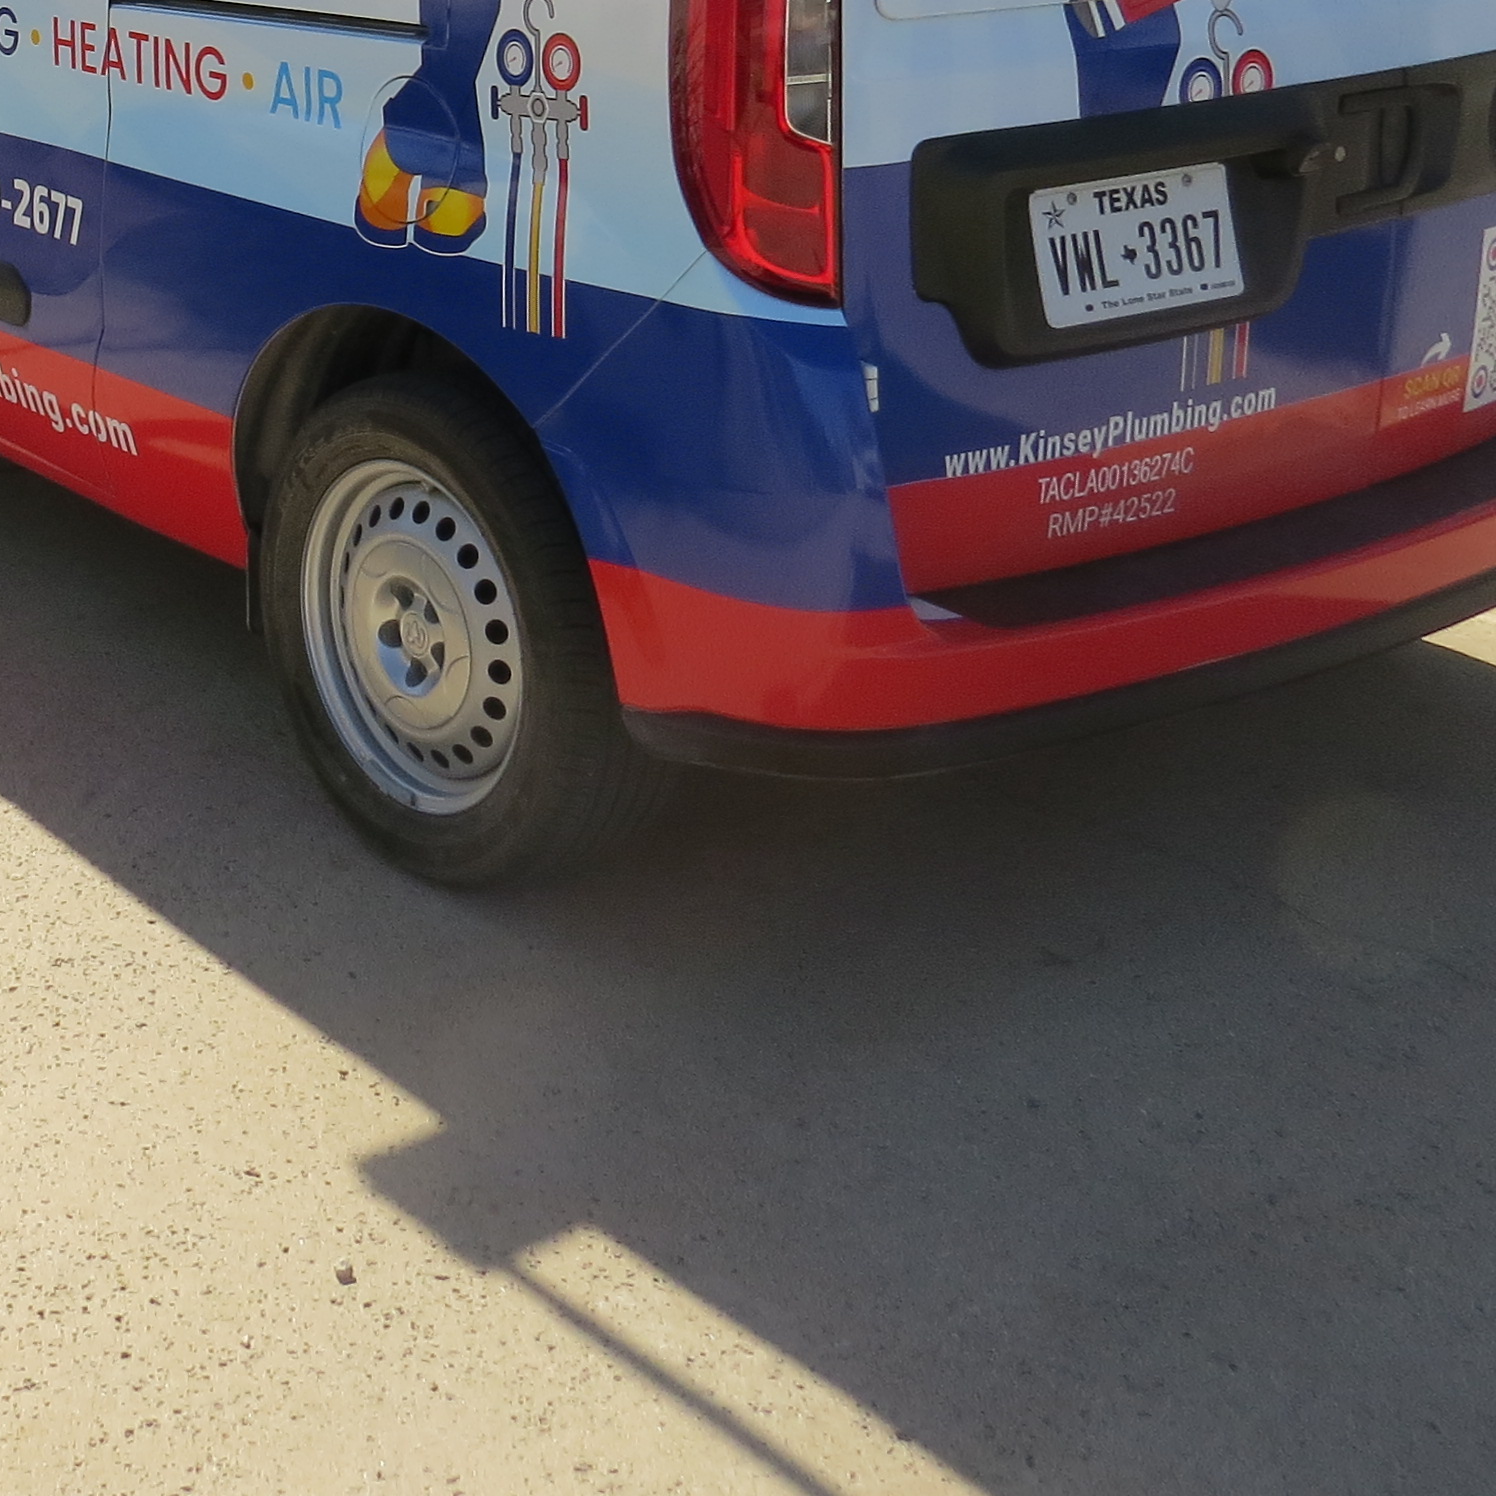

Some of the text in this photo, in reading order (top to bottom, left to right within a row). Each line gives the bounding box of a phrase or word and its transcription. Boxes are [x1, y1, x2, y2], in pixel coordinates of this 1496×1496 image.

[53, 16, 227, 101] HEATING
[270, 61, 343, 129] AIR
[1094, 182, 1168, 216] TEXAS
[1048, 209, 1221, 296] VWL 3367
[944, 387, 1277, 478] www.KinseyPlumbing.com
[1038, 447, 1195, 505] TACLA00136274C
[1047, 488, 1177, 539] RMP#42522
